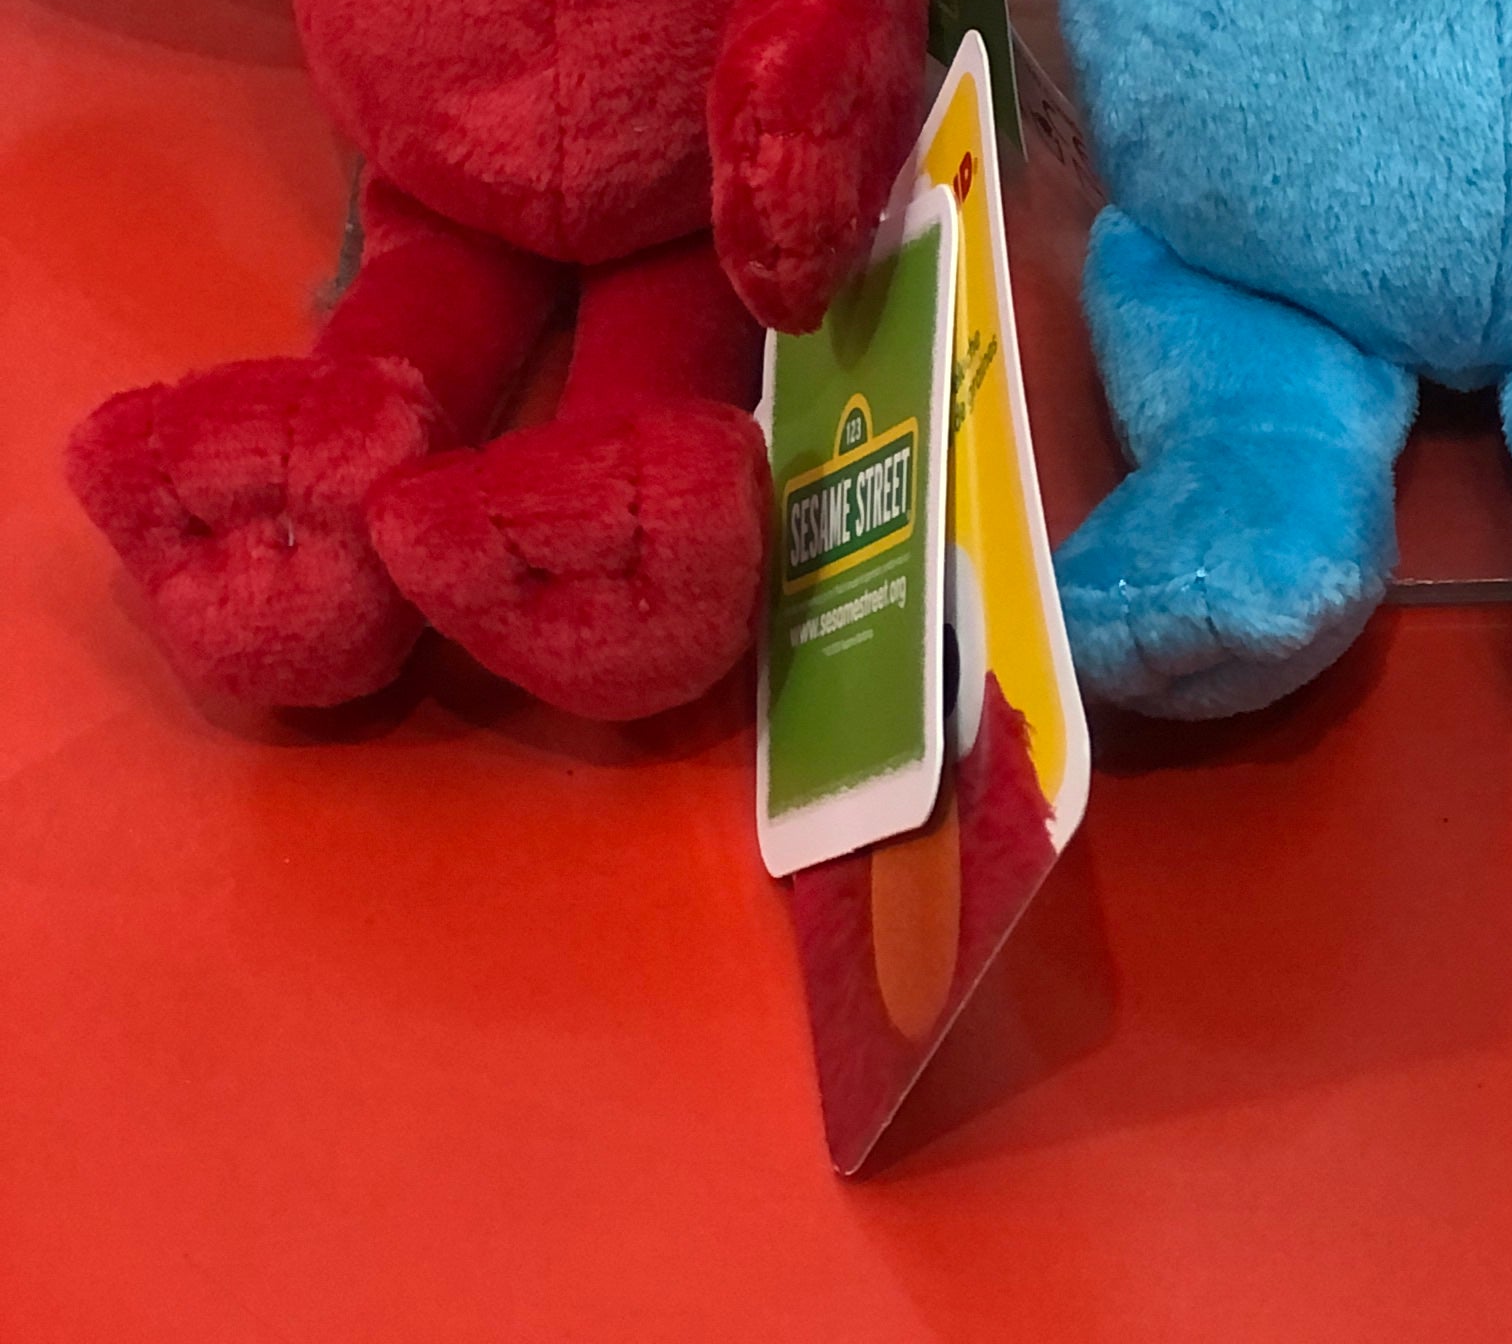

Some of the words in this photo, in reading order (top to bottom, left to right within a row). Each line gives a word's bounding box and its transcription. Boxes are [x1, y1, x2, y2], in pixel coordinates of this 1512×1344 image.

[845, 416, 862, 446] 123
[790, 478, 852, 567] SESAME
[855, 446, 911, 537] STREET
